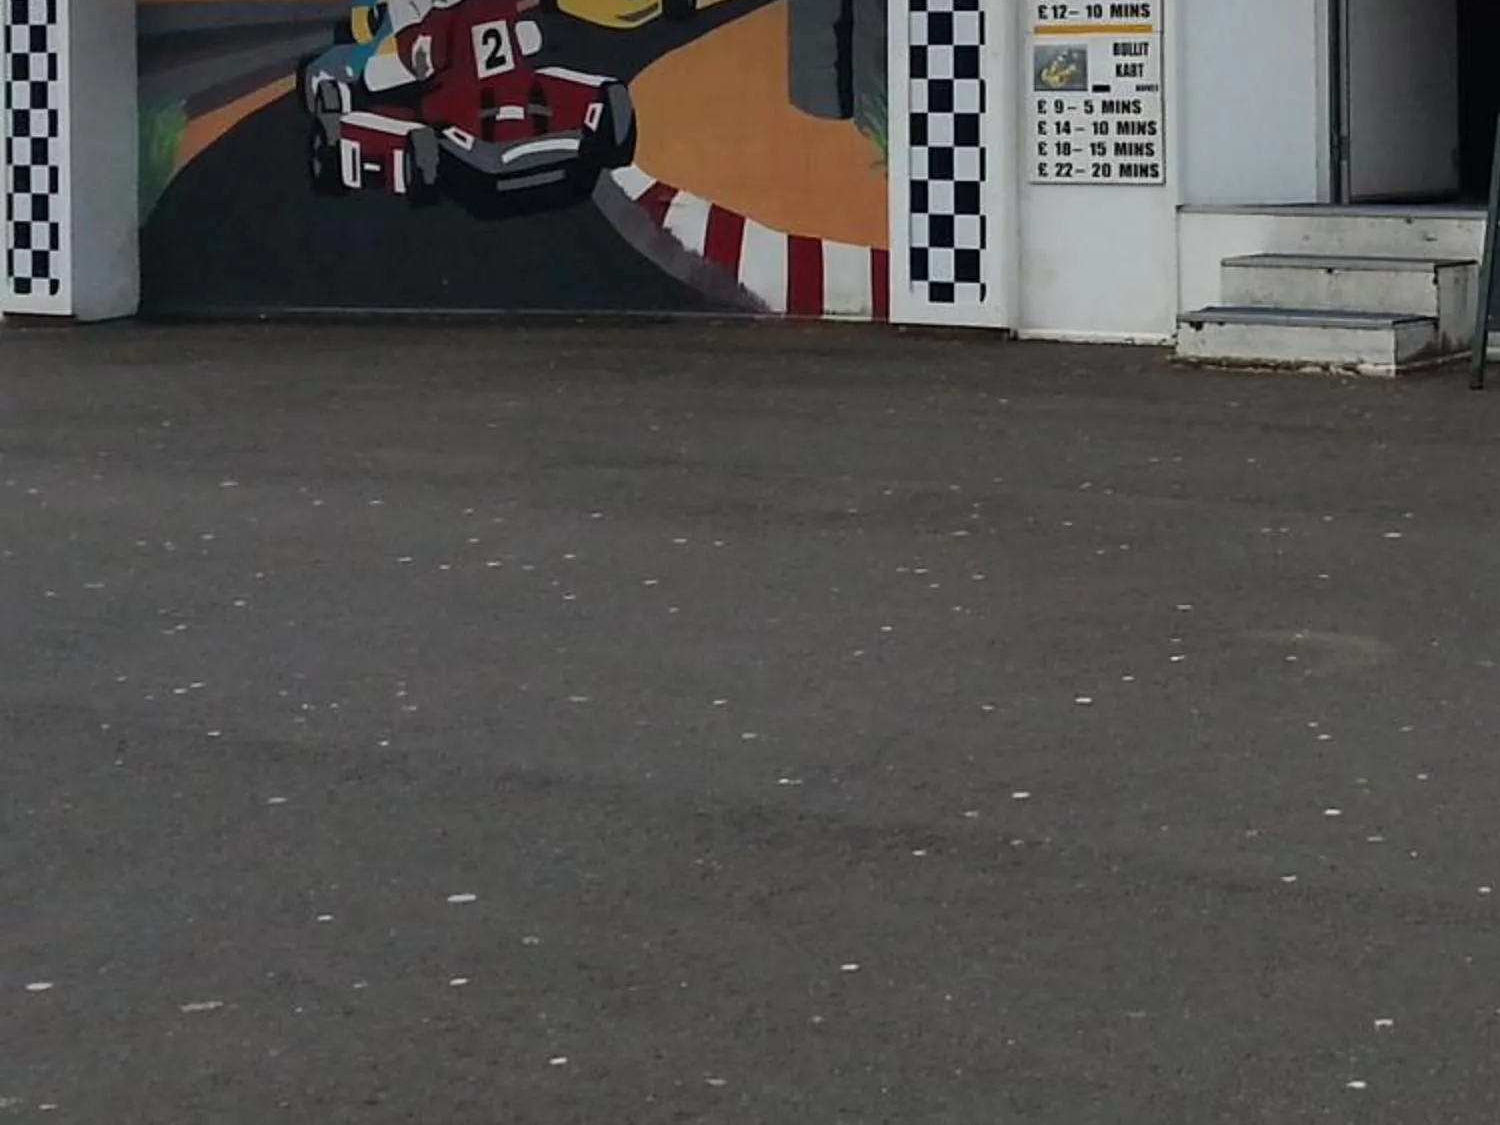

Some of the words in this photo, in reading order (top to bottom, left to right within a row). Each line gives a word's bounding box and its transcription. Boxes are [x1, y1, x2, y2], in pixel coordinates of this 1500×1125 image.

[1110, 3, 1151, 17] MINS
[480, 29, 504, 69] 2
[1113, 42, 1148, 56] BULLIT
[1116, 63, 1143, 77] KART
[1102, 100, 1142, 114] MINS
[1093, 121, 1109, 135] 10
[1116, 121, 1157, 135] MINS
[1090, 142, 1106, 156] 15
[1114, 142, 1155, 156] MINS
[1092, 163, 1111, 177] 20
[1119, 163, 1159, 177] MINS
